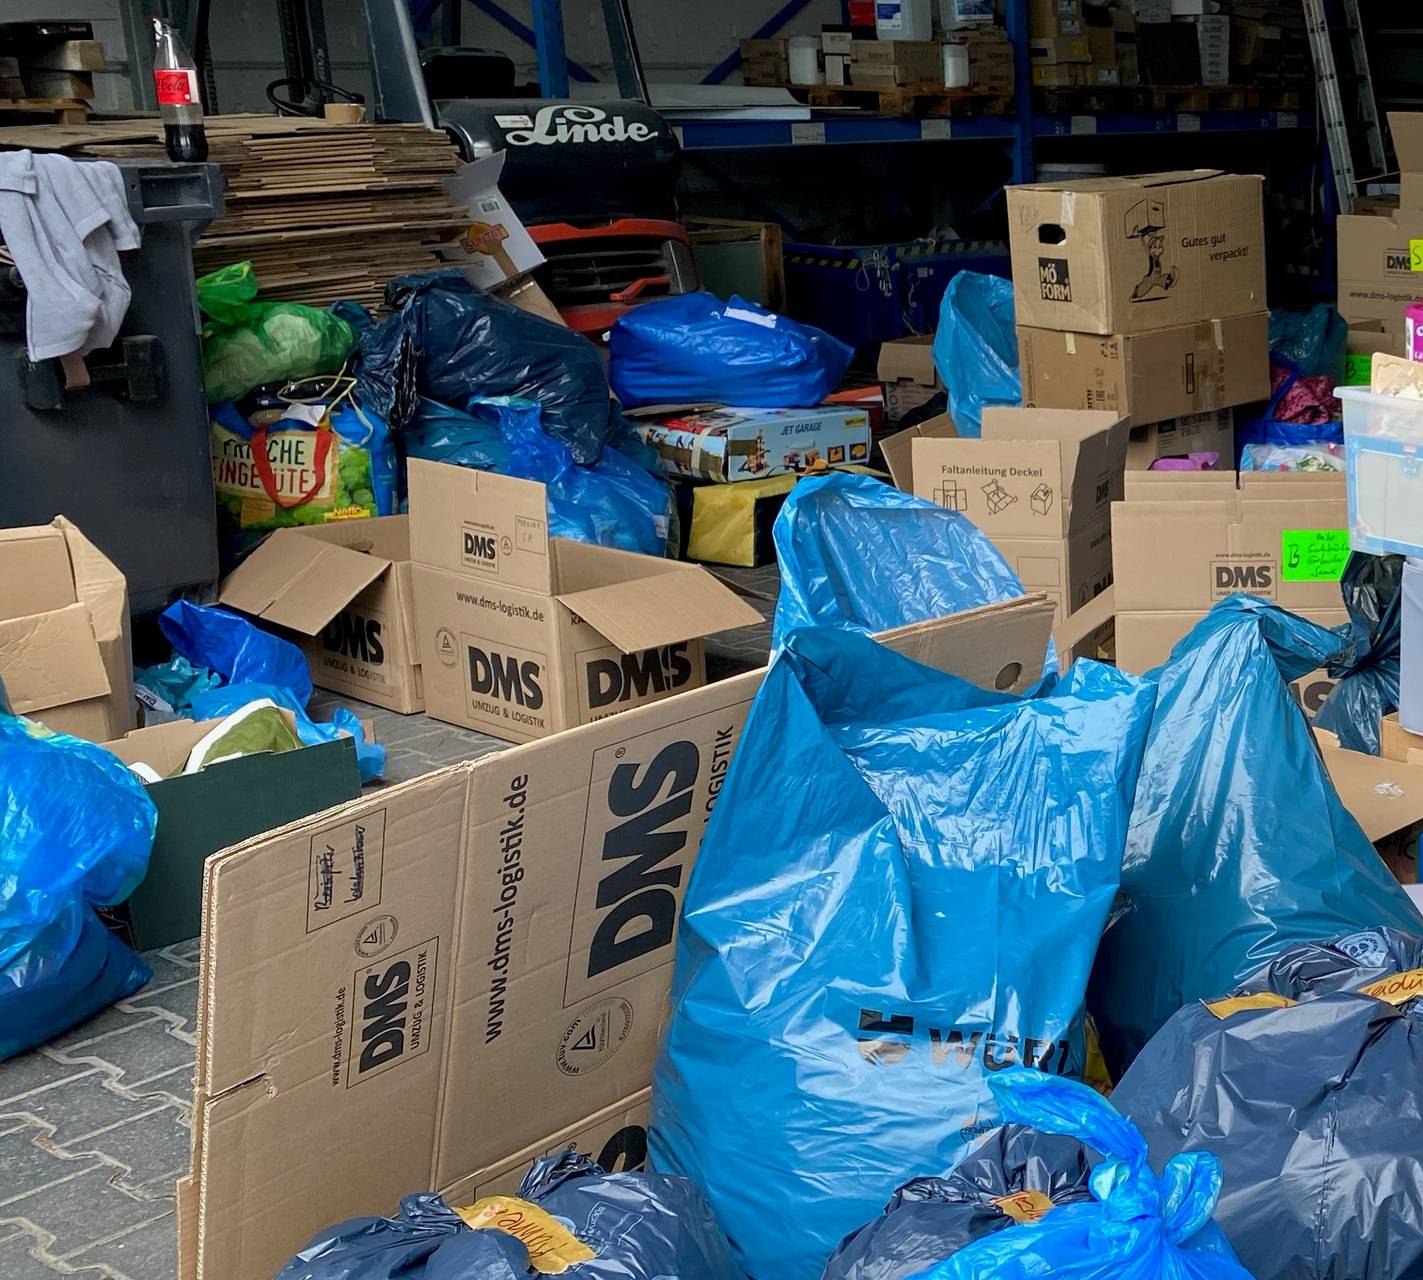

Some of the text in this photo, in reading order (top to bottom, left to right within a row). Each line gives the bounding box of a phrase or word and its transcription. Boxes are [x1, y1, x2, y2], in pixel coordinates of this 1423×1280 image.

[506, 105, 658, 146] Linde
[1181, 234, 1226, 248] Gutes gut
[1040, 263, 1057, 283] MÖ
[1041, 283, 1072, 300] FORM
[781, 422, 821, 435] JET GARAGE
[942, 465, 1043, 477] Faltanleitung Deckel
[464, 533, 496, 560] DMS
[1216, 566, 1272, 588] DMS
[456, 592, 544, 622] www.dms-logistik.de
[468, 646, 544, 711] DMS
[586, 642, 692, 709] DMS
[472, 700, 546, 729] UMZUG & LOGISTIK
[704, 725, 734, 824] OGISTIK
[587, 740, 700, 978] DMS
[486, 774, 529, 1045] www.dms-logistik.de
[358, 960, 411, 1074] DMS
[410, 950, 428, 1050] UMZUG & LOGISTIK
[332, 986, 346, 1087] www.dms-logistik.de
